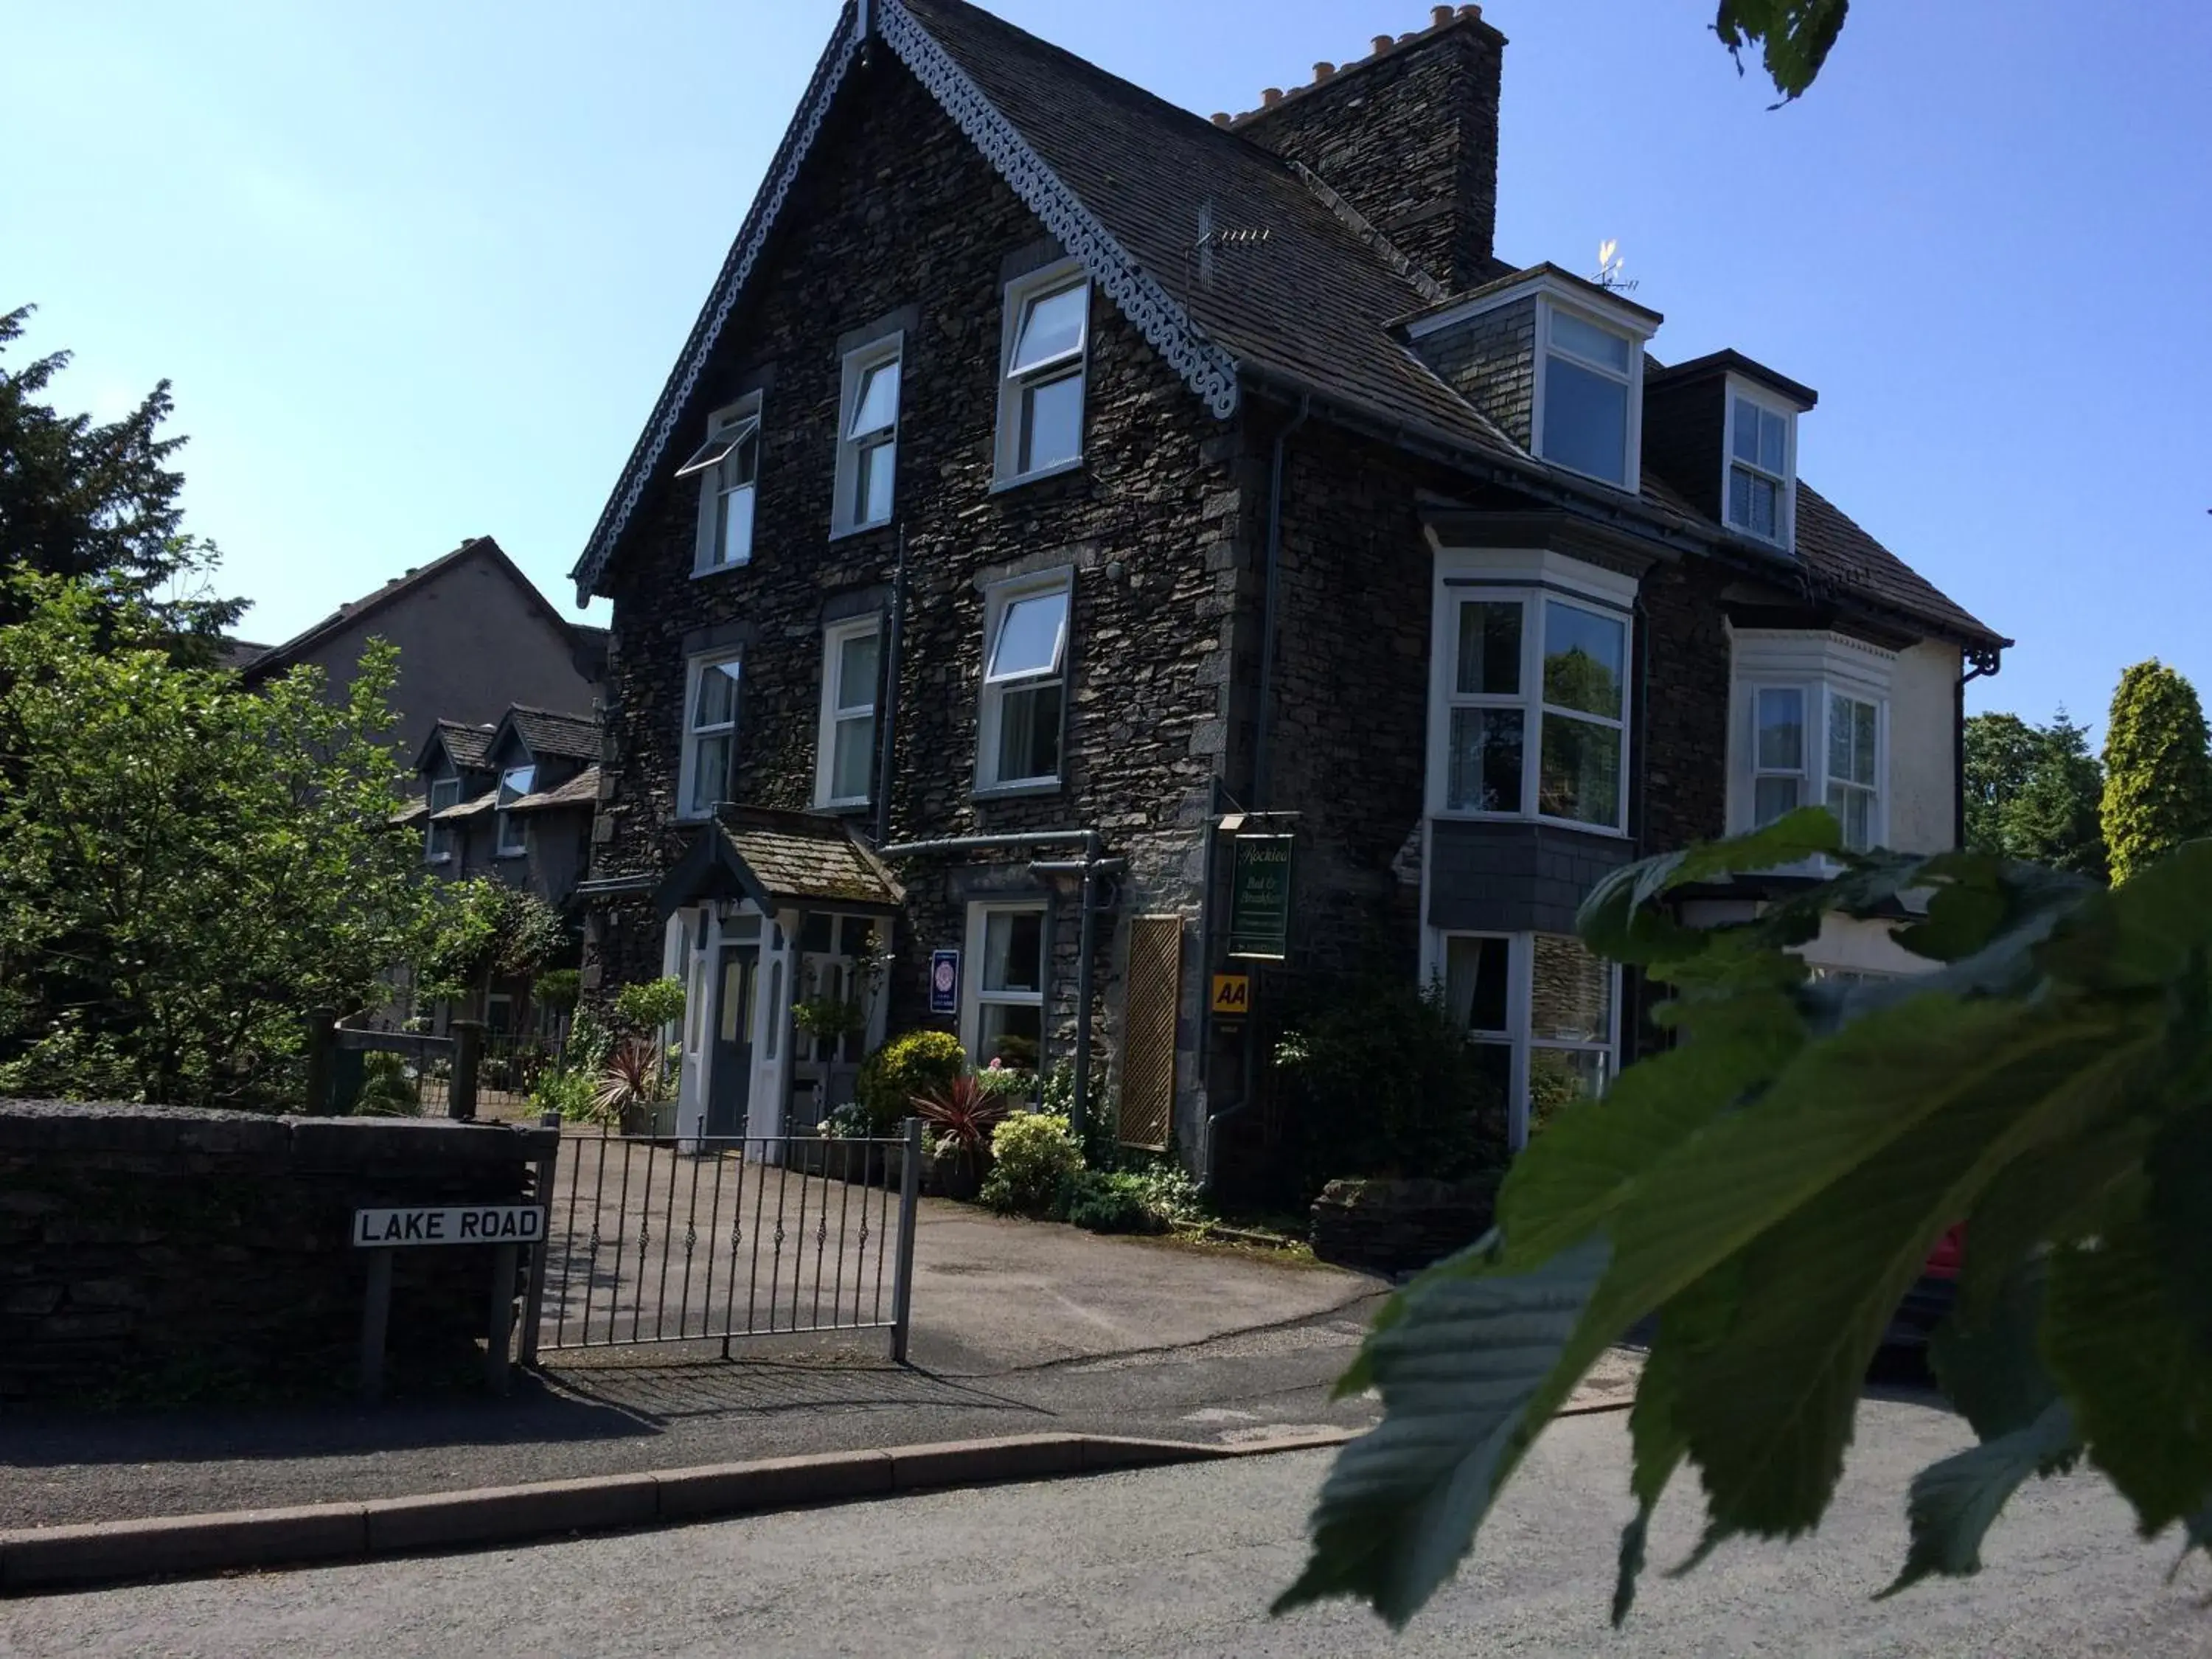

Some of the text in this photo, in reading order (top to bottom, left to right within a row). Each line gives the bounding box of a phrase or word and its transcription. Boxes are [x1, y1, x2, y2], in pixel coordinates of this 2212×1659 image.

[1217, 982, 1246, 1004] AA
[361, 1210, 538, 1241] LAKE ROAD
